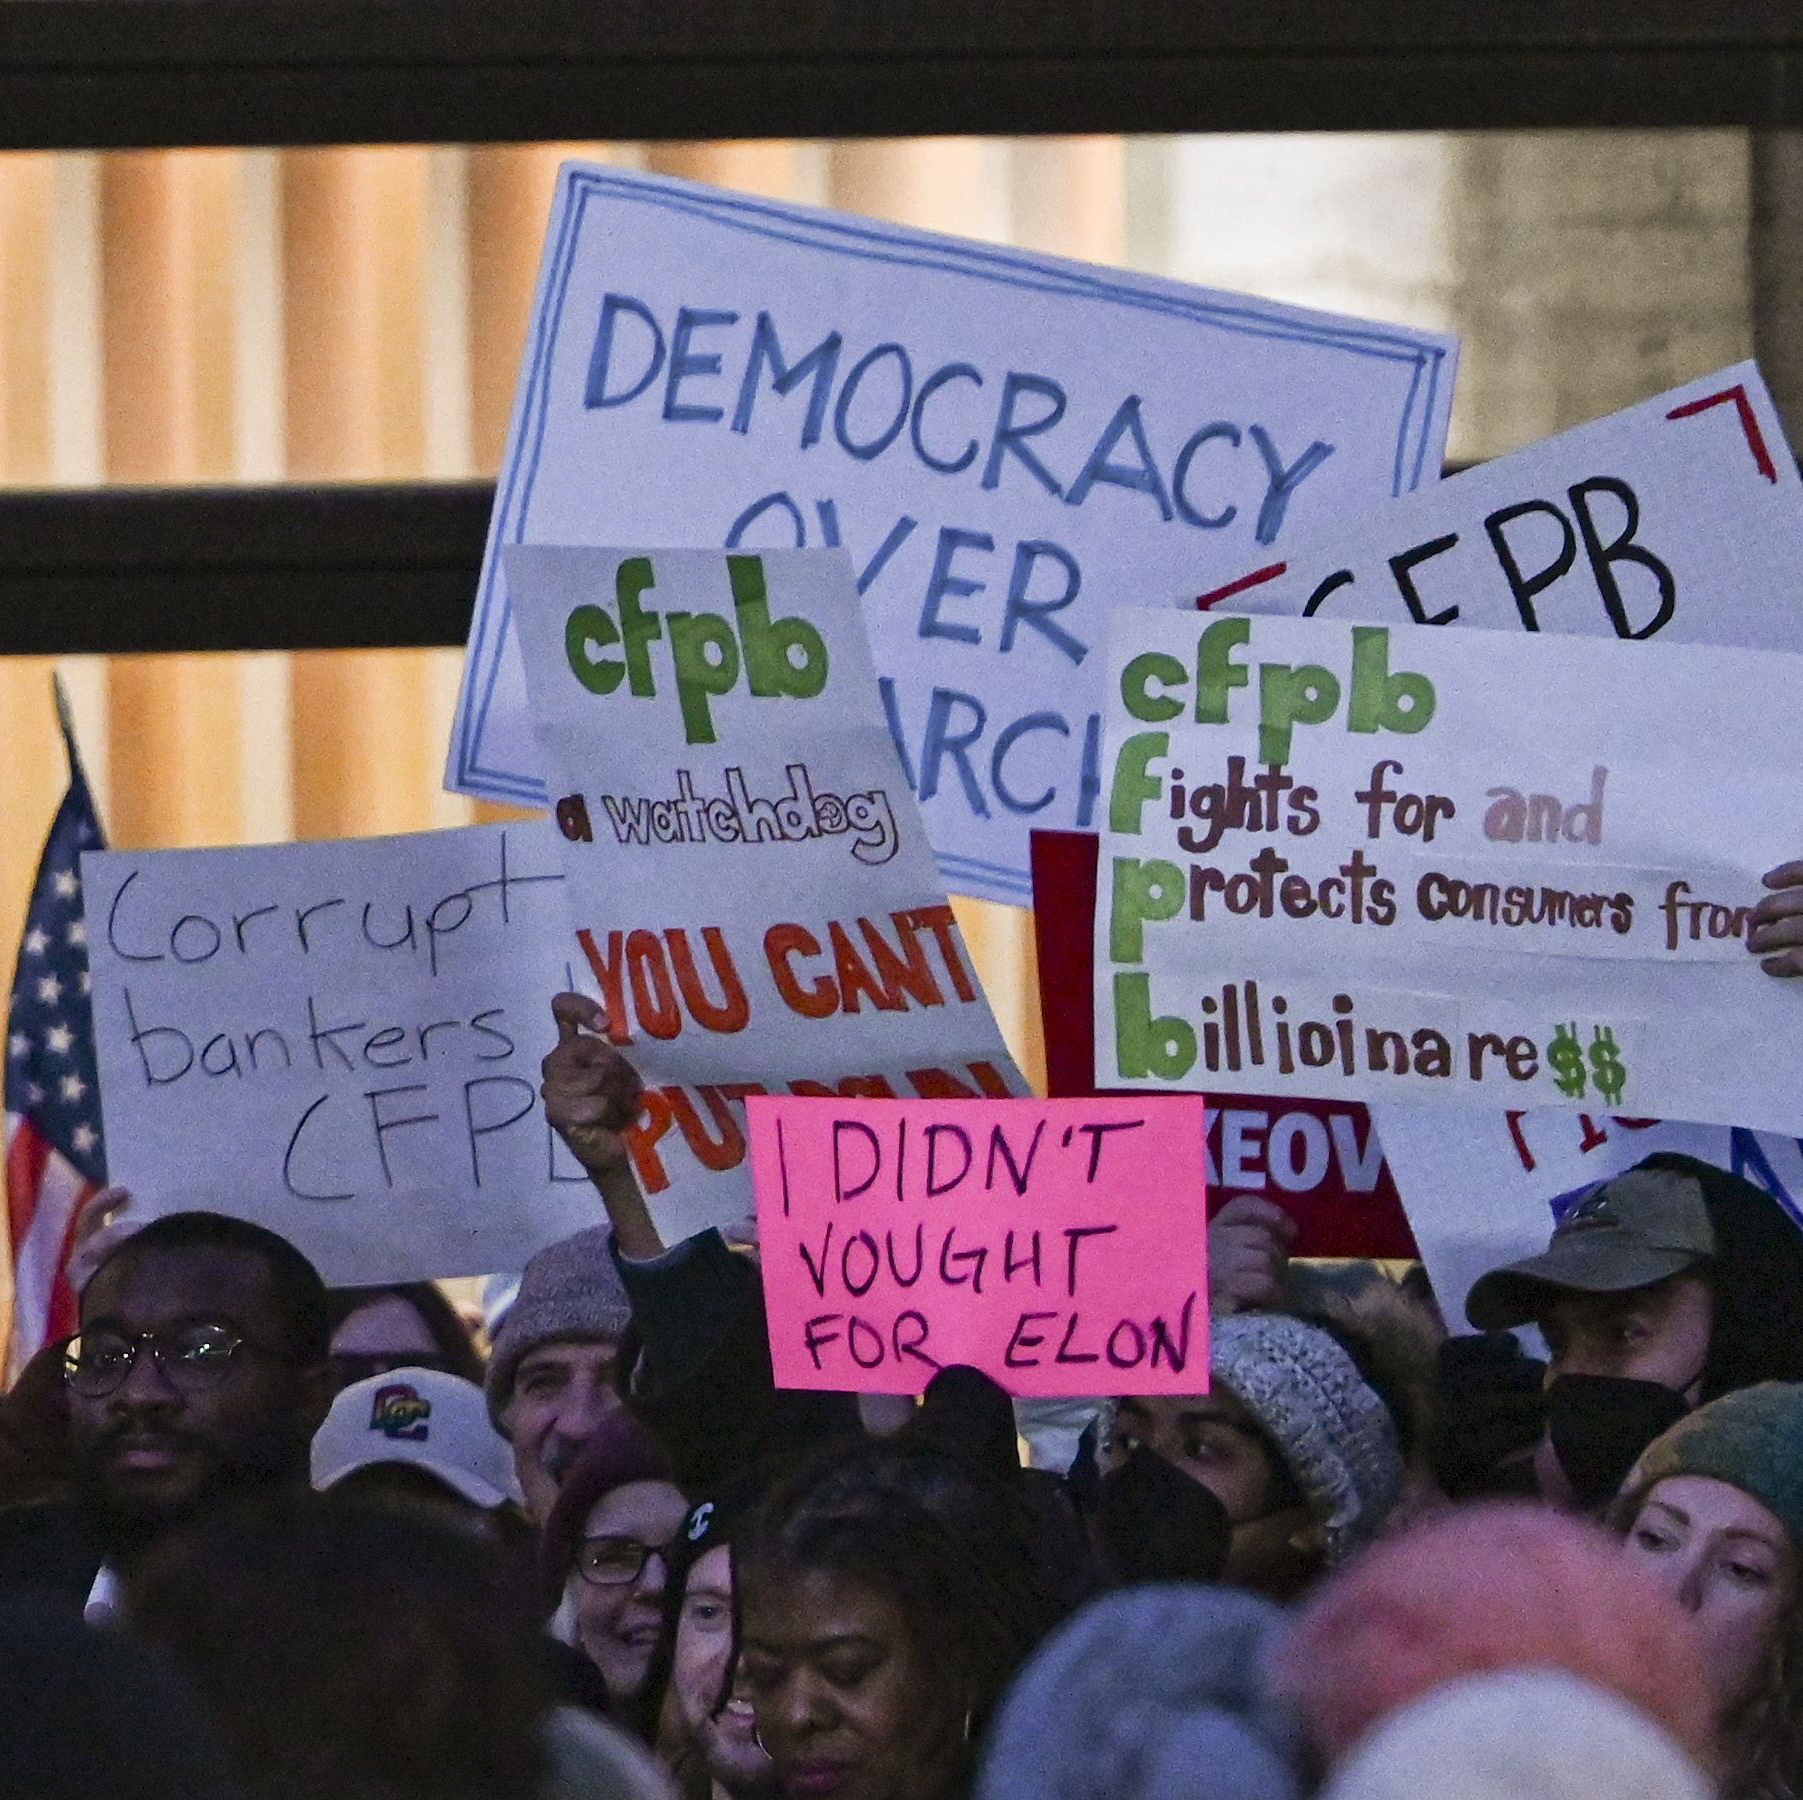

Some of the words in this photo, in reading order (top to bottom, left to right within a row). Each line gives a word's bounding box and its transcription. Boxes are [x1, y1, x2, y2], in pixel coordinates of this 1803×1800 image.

[585, 293, 1334, 544] DEMOCRACY
[565, 554, 830, 745] cfpb
[1120, 614, 1438, 766] cfpb
[556, 792, 592, 841] a
[603, 763, 897, 865] watchdog
[1109, 731, 1321, 853] fights
[1356, 762, 1456, 847] for
[1485, 767, 1608, 847] and
[107, 830, 565, 979] Corrupt
[1109, 848, 1397, 967] protects
[1416, 870, 1635, 936] consumers
[130, 988, 518, 1087] bankers
[576, 926, 751, 1046] YOU
[622, 1082, 767, 1194] PU
[776, 1117, 791, 1217] I
[832, 1118, 1145, 1204] DIDN'T
[797, 1223, 1119, 1300] VOUGHT
[804, 1310, 942, 1373] FOR
[1004, 1288, 1197, 1374] ELON
